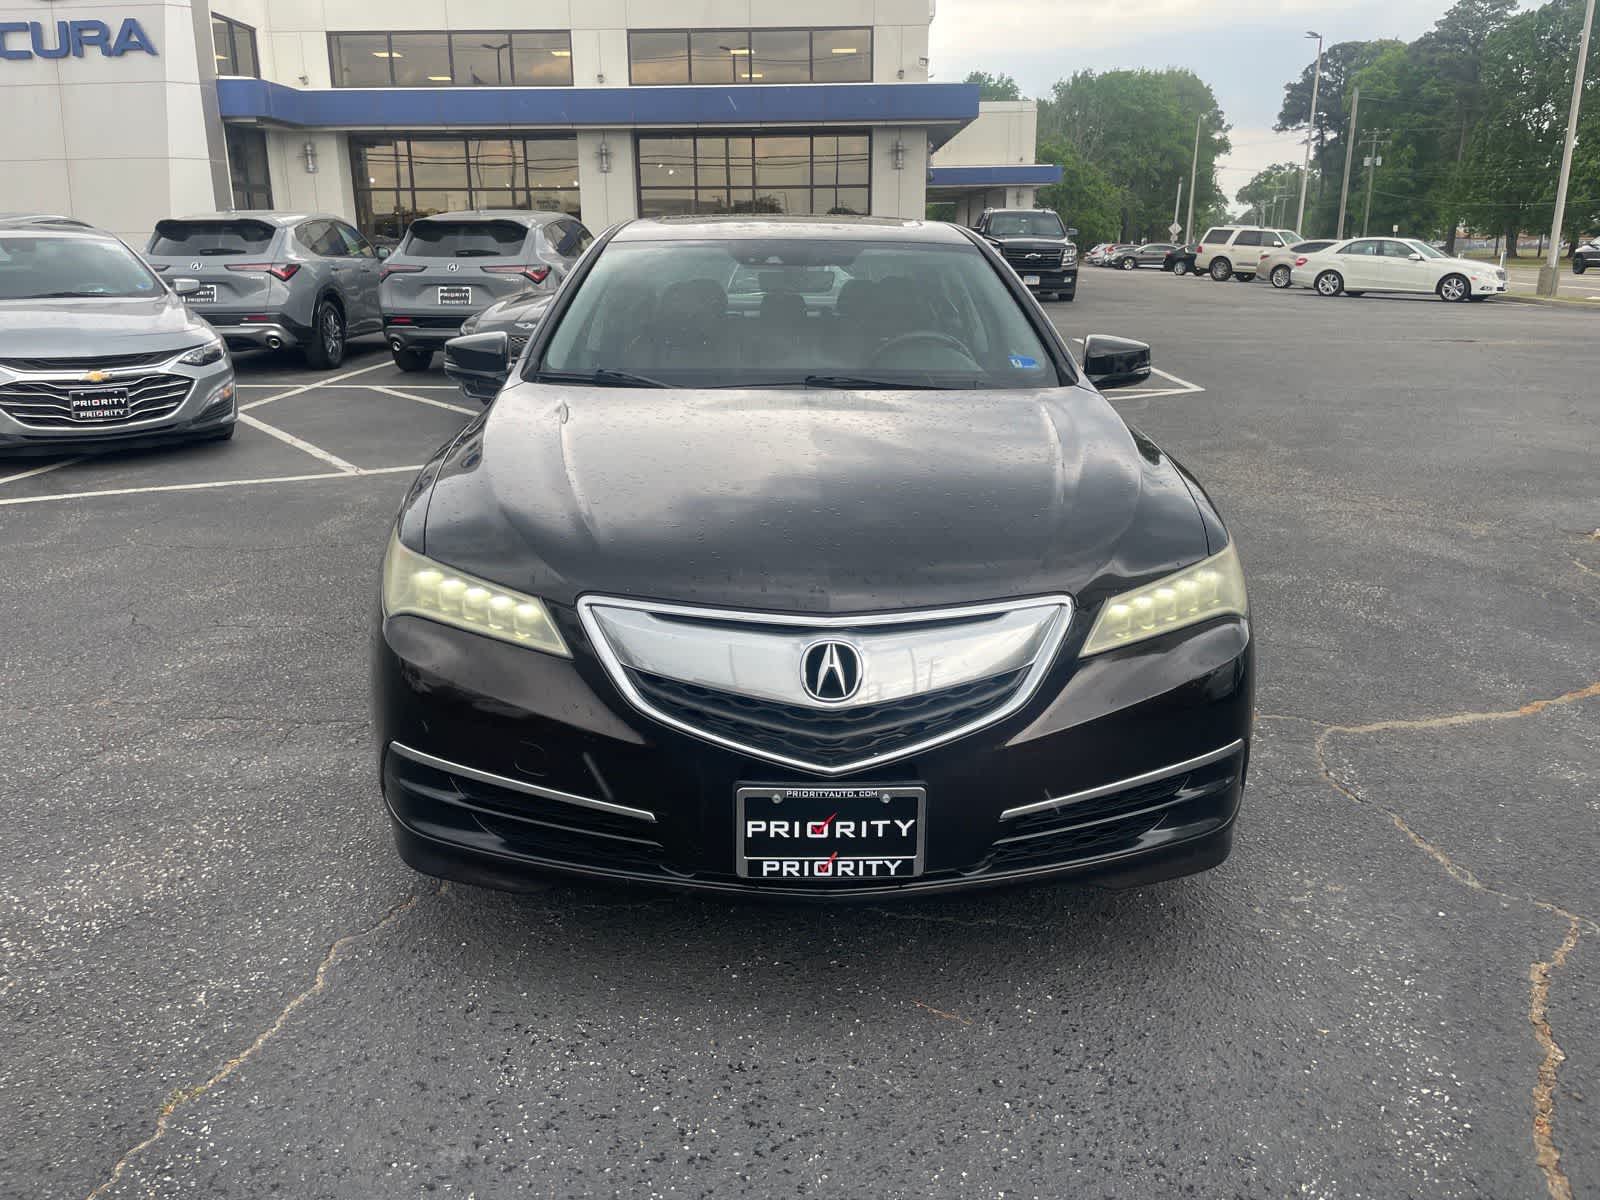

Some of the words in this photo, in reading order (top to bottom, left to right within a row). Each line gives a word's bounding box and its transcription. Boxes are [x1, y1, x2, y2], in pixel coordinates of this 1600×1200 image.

[72, 398, 127, 407] PRIORITY
[80, 409, 125, 418] PRIORITY
[747, 819, 915, 838] PRIORITY
[762, 860, 902, 876] PRIORITY
